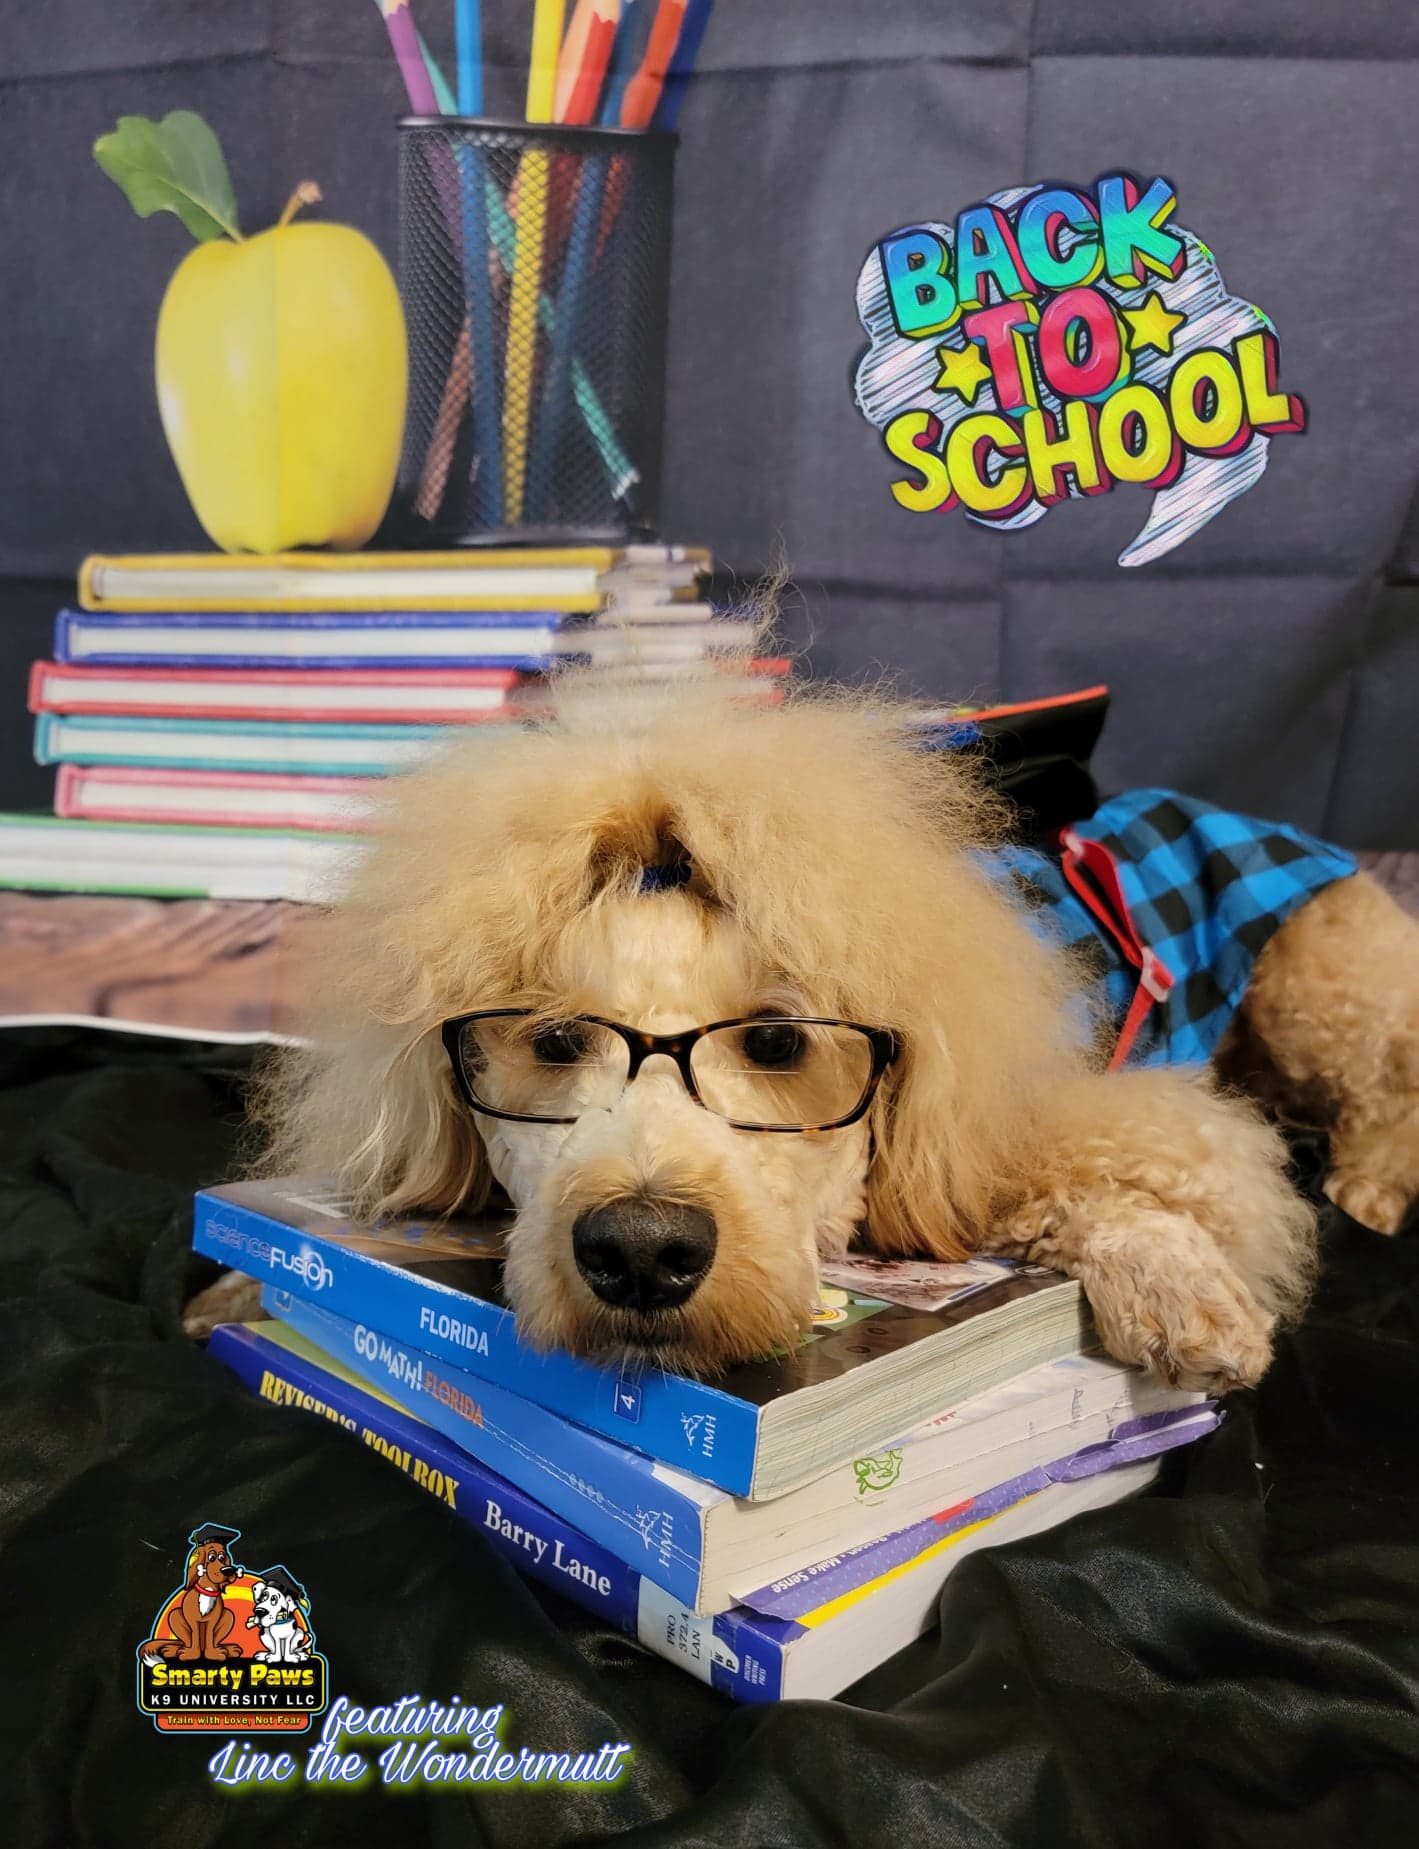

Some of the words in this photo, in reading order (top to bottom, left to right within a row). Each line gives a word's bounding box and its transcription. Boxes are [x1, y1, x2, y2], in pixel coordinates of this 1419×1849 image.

[419, 1306, 490, 1356] FLORIDA
[354, 1324, 379, 1361] GO
[379, 1339, 423, 1391] MATH!
[424, 1371, 484, 1429] FLORIDA
[620, 1393, 635, 1410] 4
[702, 1414, 717, 1458] HMH
[484, 1501, 548, 1563] Barry
[552, 1541, 611, 1595] Lane
[658, 1511, 674, 1567] HMH
[771, 1572, 809, 1593] Sense
[666, 1614, 676, 1646] PRO
[692, 1630, 701, 1660] LAN
[725, 1659, 736, 1671] P
